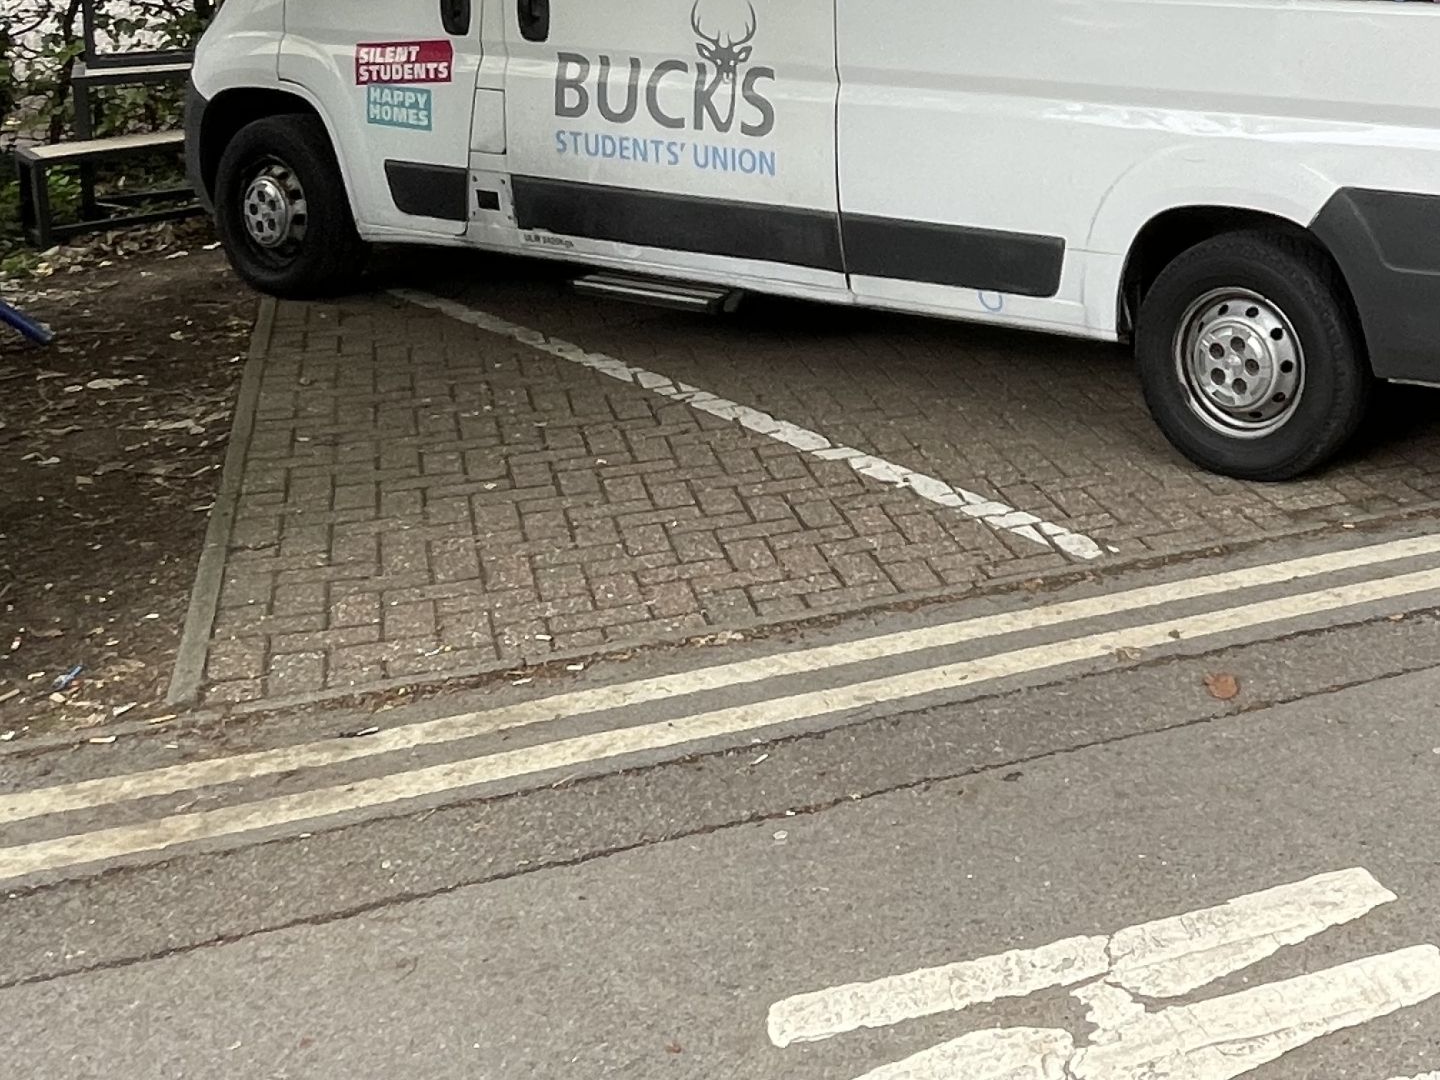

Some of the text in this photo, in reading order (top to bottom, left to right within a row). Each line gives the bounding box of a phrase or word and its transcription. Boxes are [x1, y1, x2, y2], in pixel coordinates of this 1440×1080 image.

[358, 45, 420, 64] SILENT
[358, 61, 449, 81] STUDENTS
[369, 86, 429, 109] HAPPY
[554, 48, 775, 138] BUCKS
[368, 104, 429, 127] HOMES
[555, 129, 776, 177] STUDENTS' UNION
